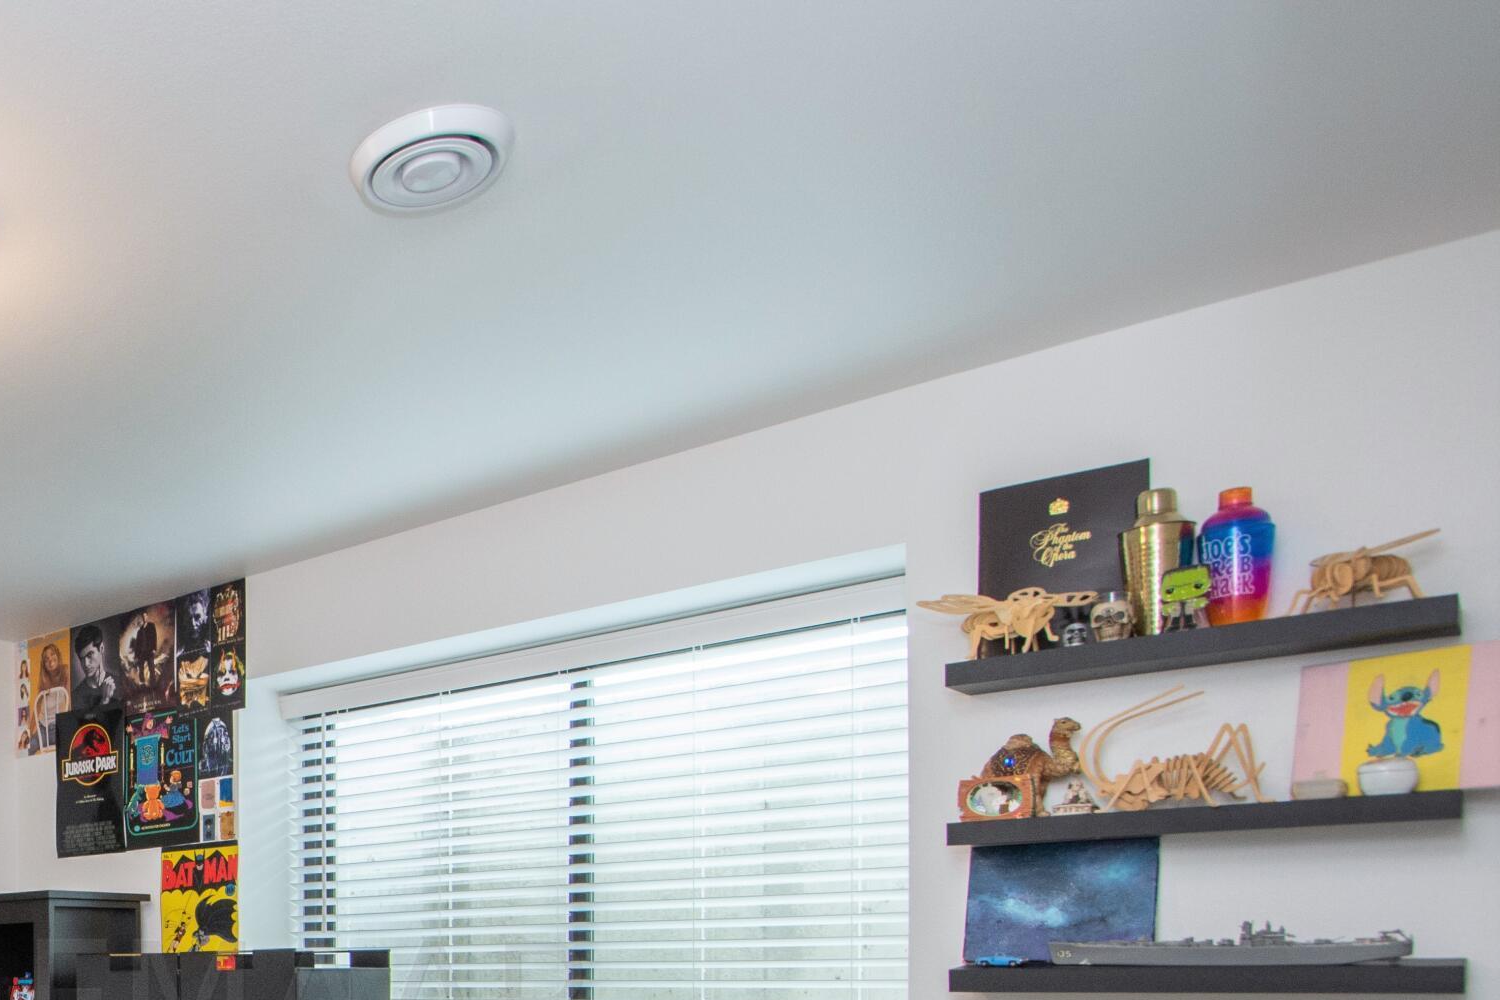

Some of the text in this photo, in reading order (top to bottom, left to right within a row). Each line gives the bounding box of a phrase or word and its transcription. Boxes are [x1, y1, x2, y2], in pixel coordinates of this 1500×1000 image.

[1030, 529, 1092, 549] Phantom
[1033, 546, 1077, 567] Opera
[171, 722, 190, 734] Let's
[171, 733, 191, 744] Start
[64, 754, 117, 778] JURASSIC PARK
